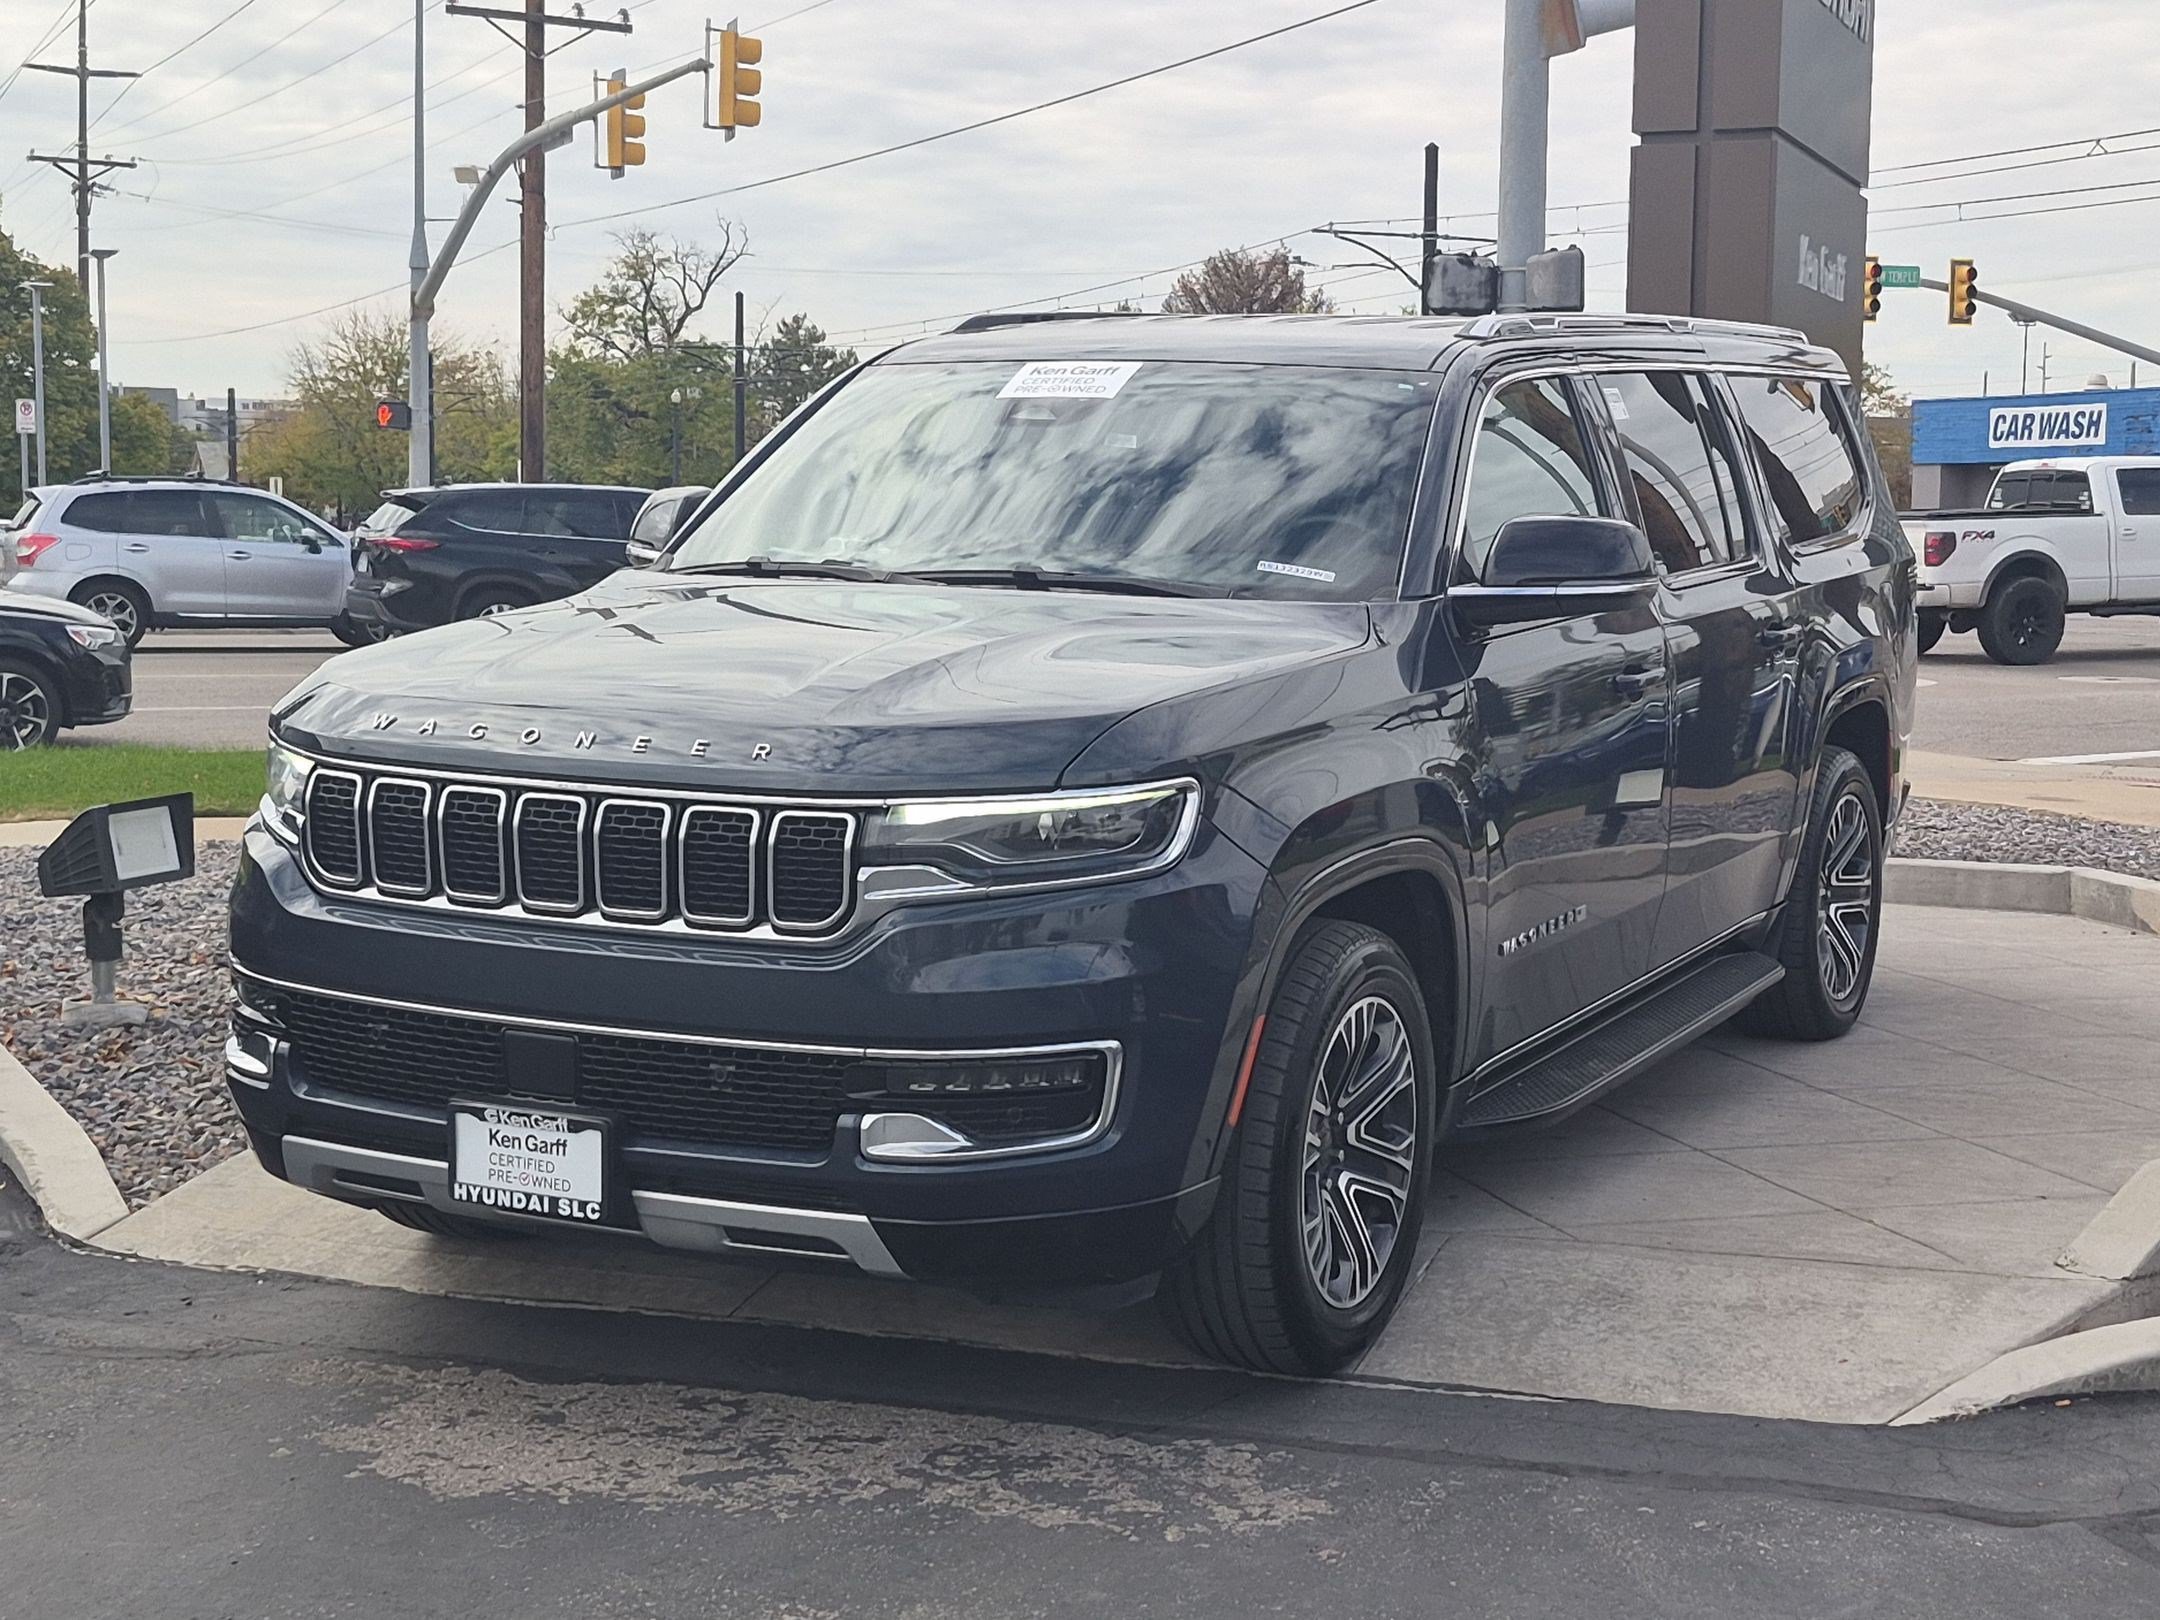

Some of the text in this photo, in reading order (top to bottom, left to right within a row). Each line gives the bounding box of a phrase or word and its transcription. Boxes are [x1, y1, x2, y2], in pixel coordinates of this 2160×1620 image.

[1798, 234, 1818, 291] Ken
[1022, 377, 1095, 385] CERTIFIED
[1030, 366, 1121, 376] Ken Garff
[1992, 410, 2103, 442] CAR WASH
[1961, 530, 1995, 543] FX4
[372, 712, 772, 762] WAGONEER
[1498, 910, 1575, 957] WAGONEER
[499, 1109, 569, 1133] Ken Garff
[489, 1128, 568, 1157] Ken Garff
[489, 1152, 555, 1173] CERTIFIED
[454, 1183, 601, 1220] HYUNDAI SLC
